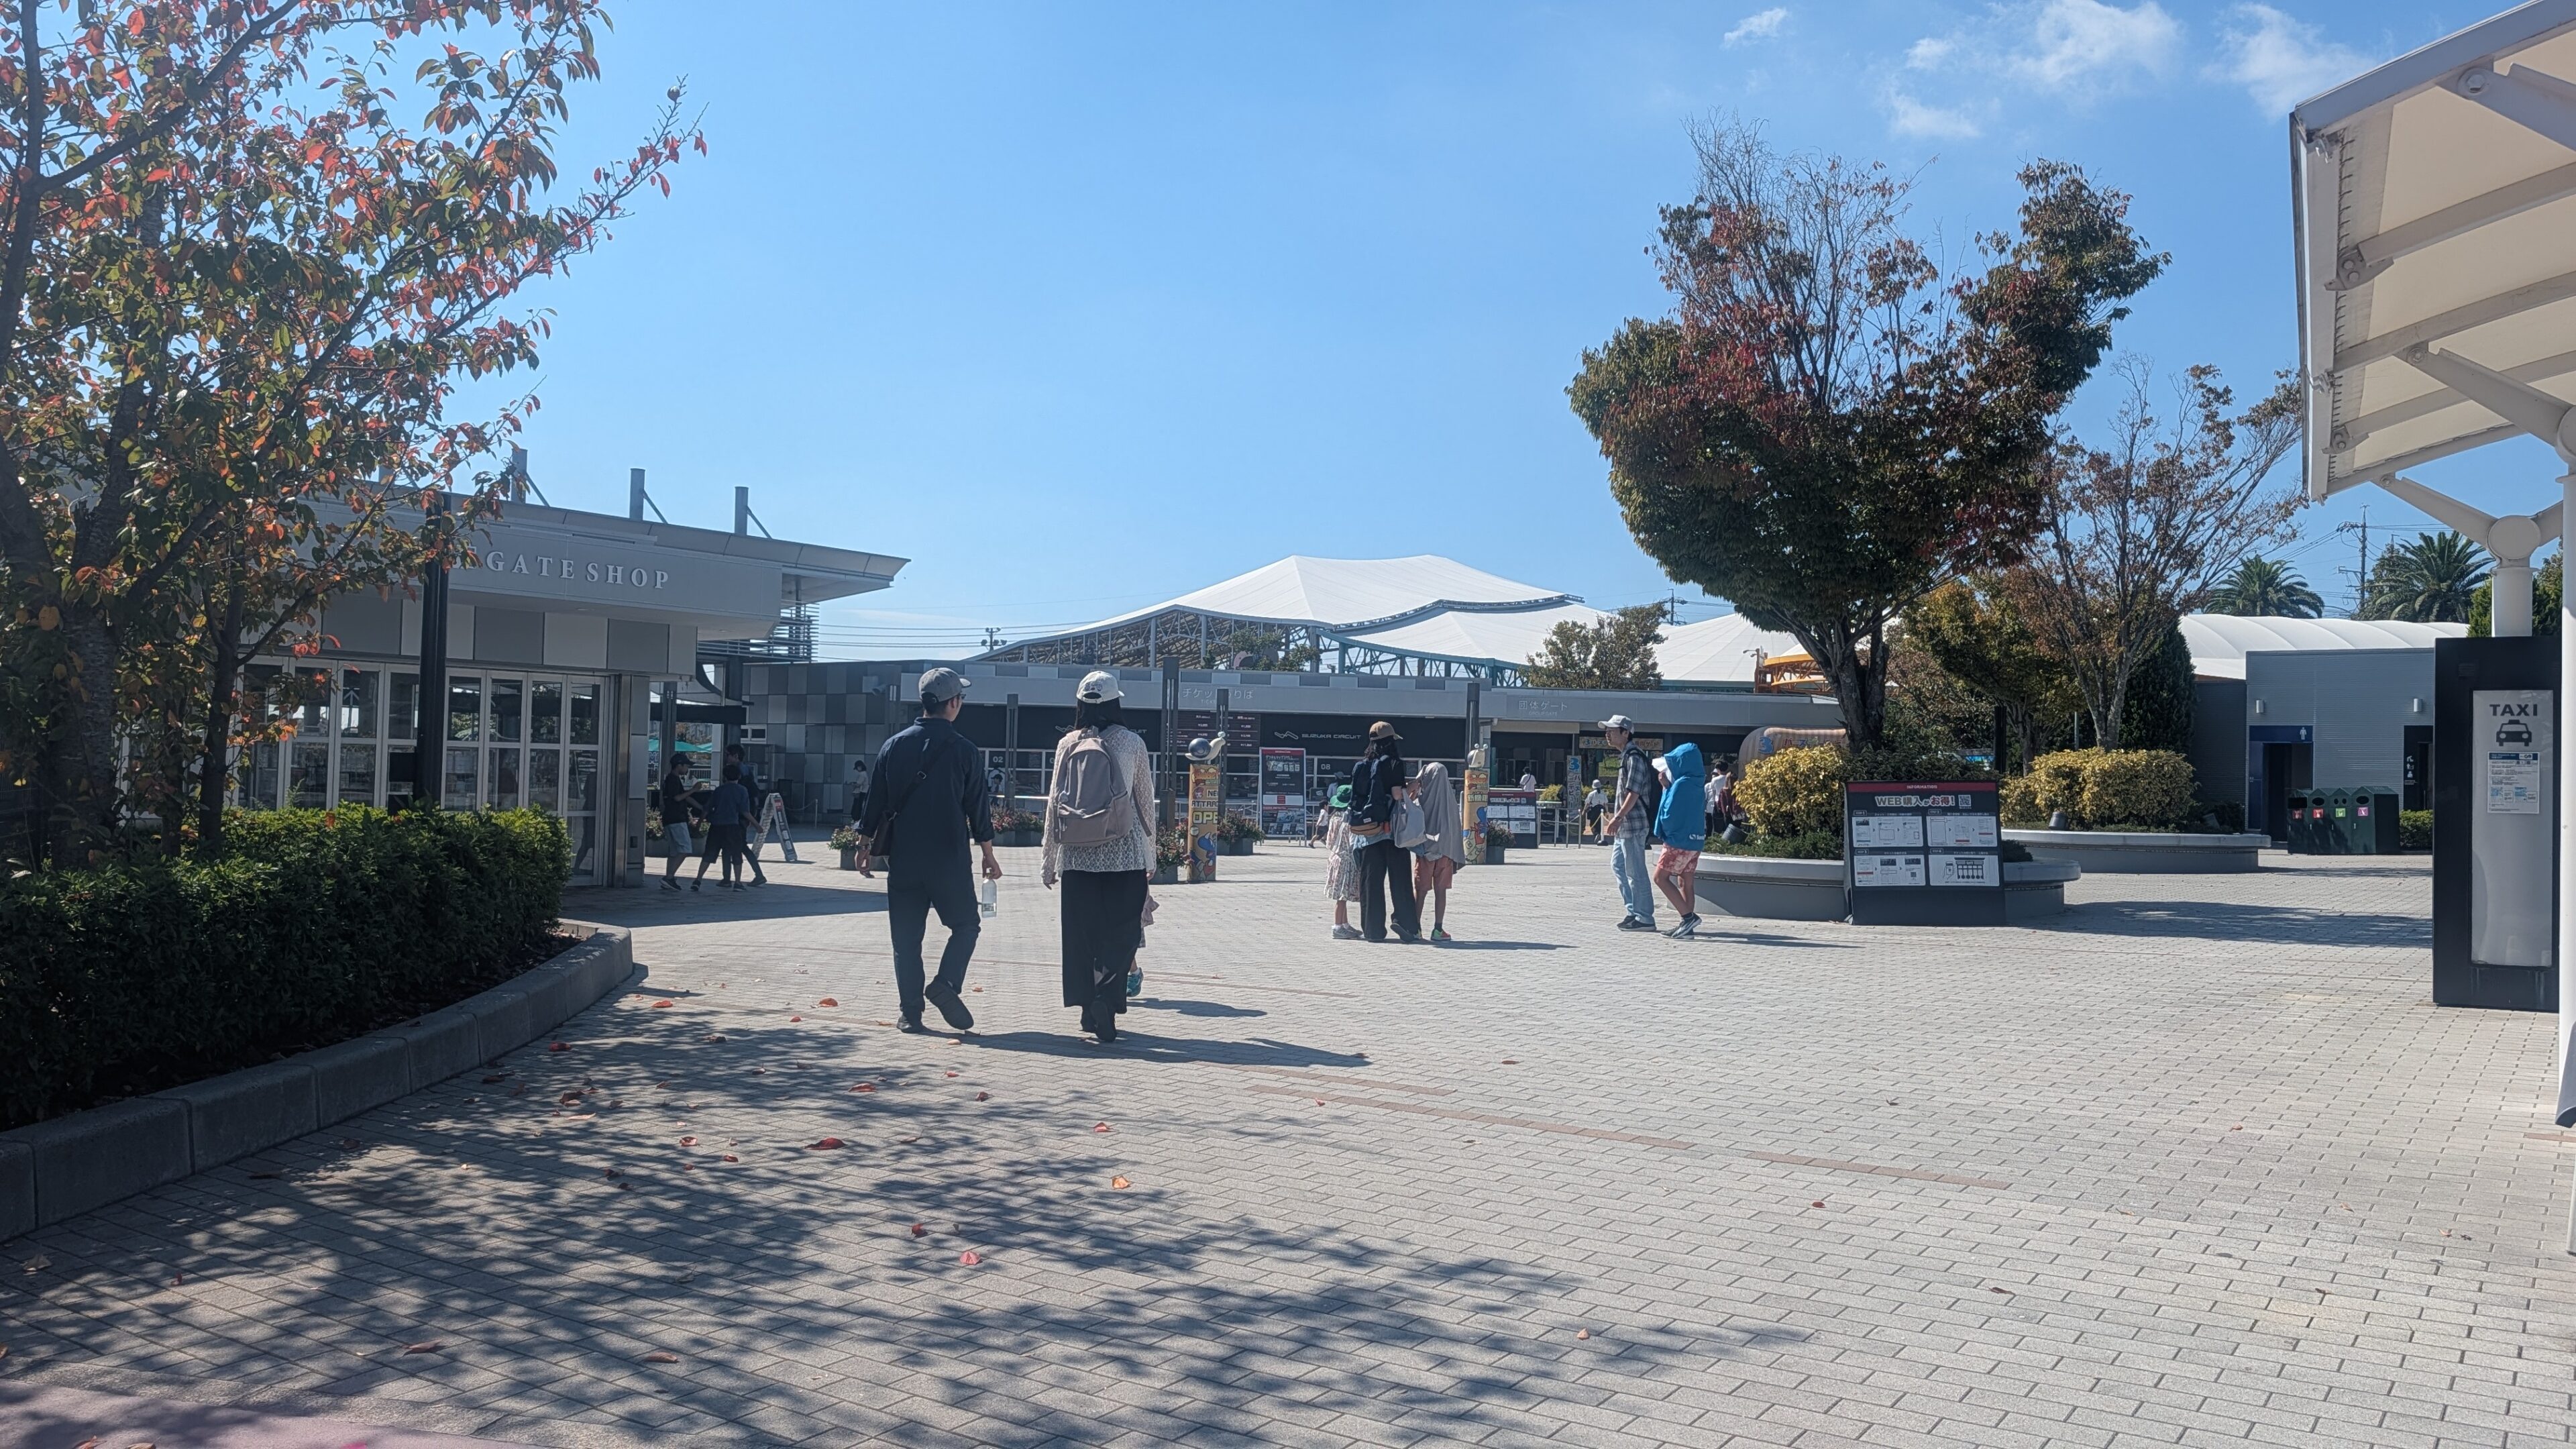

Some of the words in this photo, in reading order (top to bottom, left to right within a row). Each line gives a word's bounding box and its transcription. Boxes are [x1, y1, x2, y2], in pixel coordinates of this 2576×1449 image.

[486, 551, 575, 579] GATE
[586, 562, 668, 589] SHOP
[1182, 688, 1254, 699] チケッりば
[1519, 700, 1568, 711] 団体ゲート
[2489, 704, 2538, 716] TAXI
[1758, 736, 1774, 754] 3
[1568, 757, 1580, 770] 3
[1875, 795, 1955, 807] WEB購入がお得!
